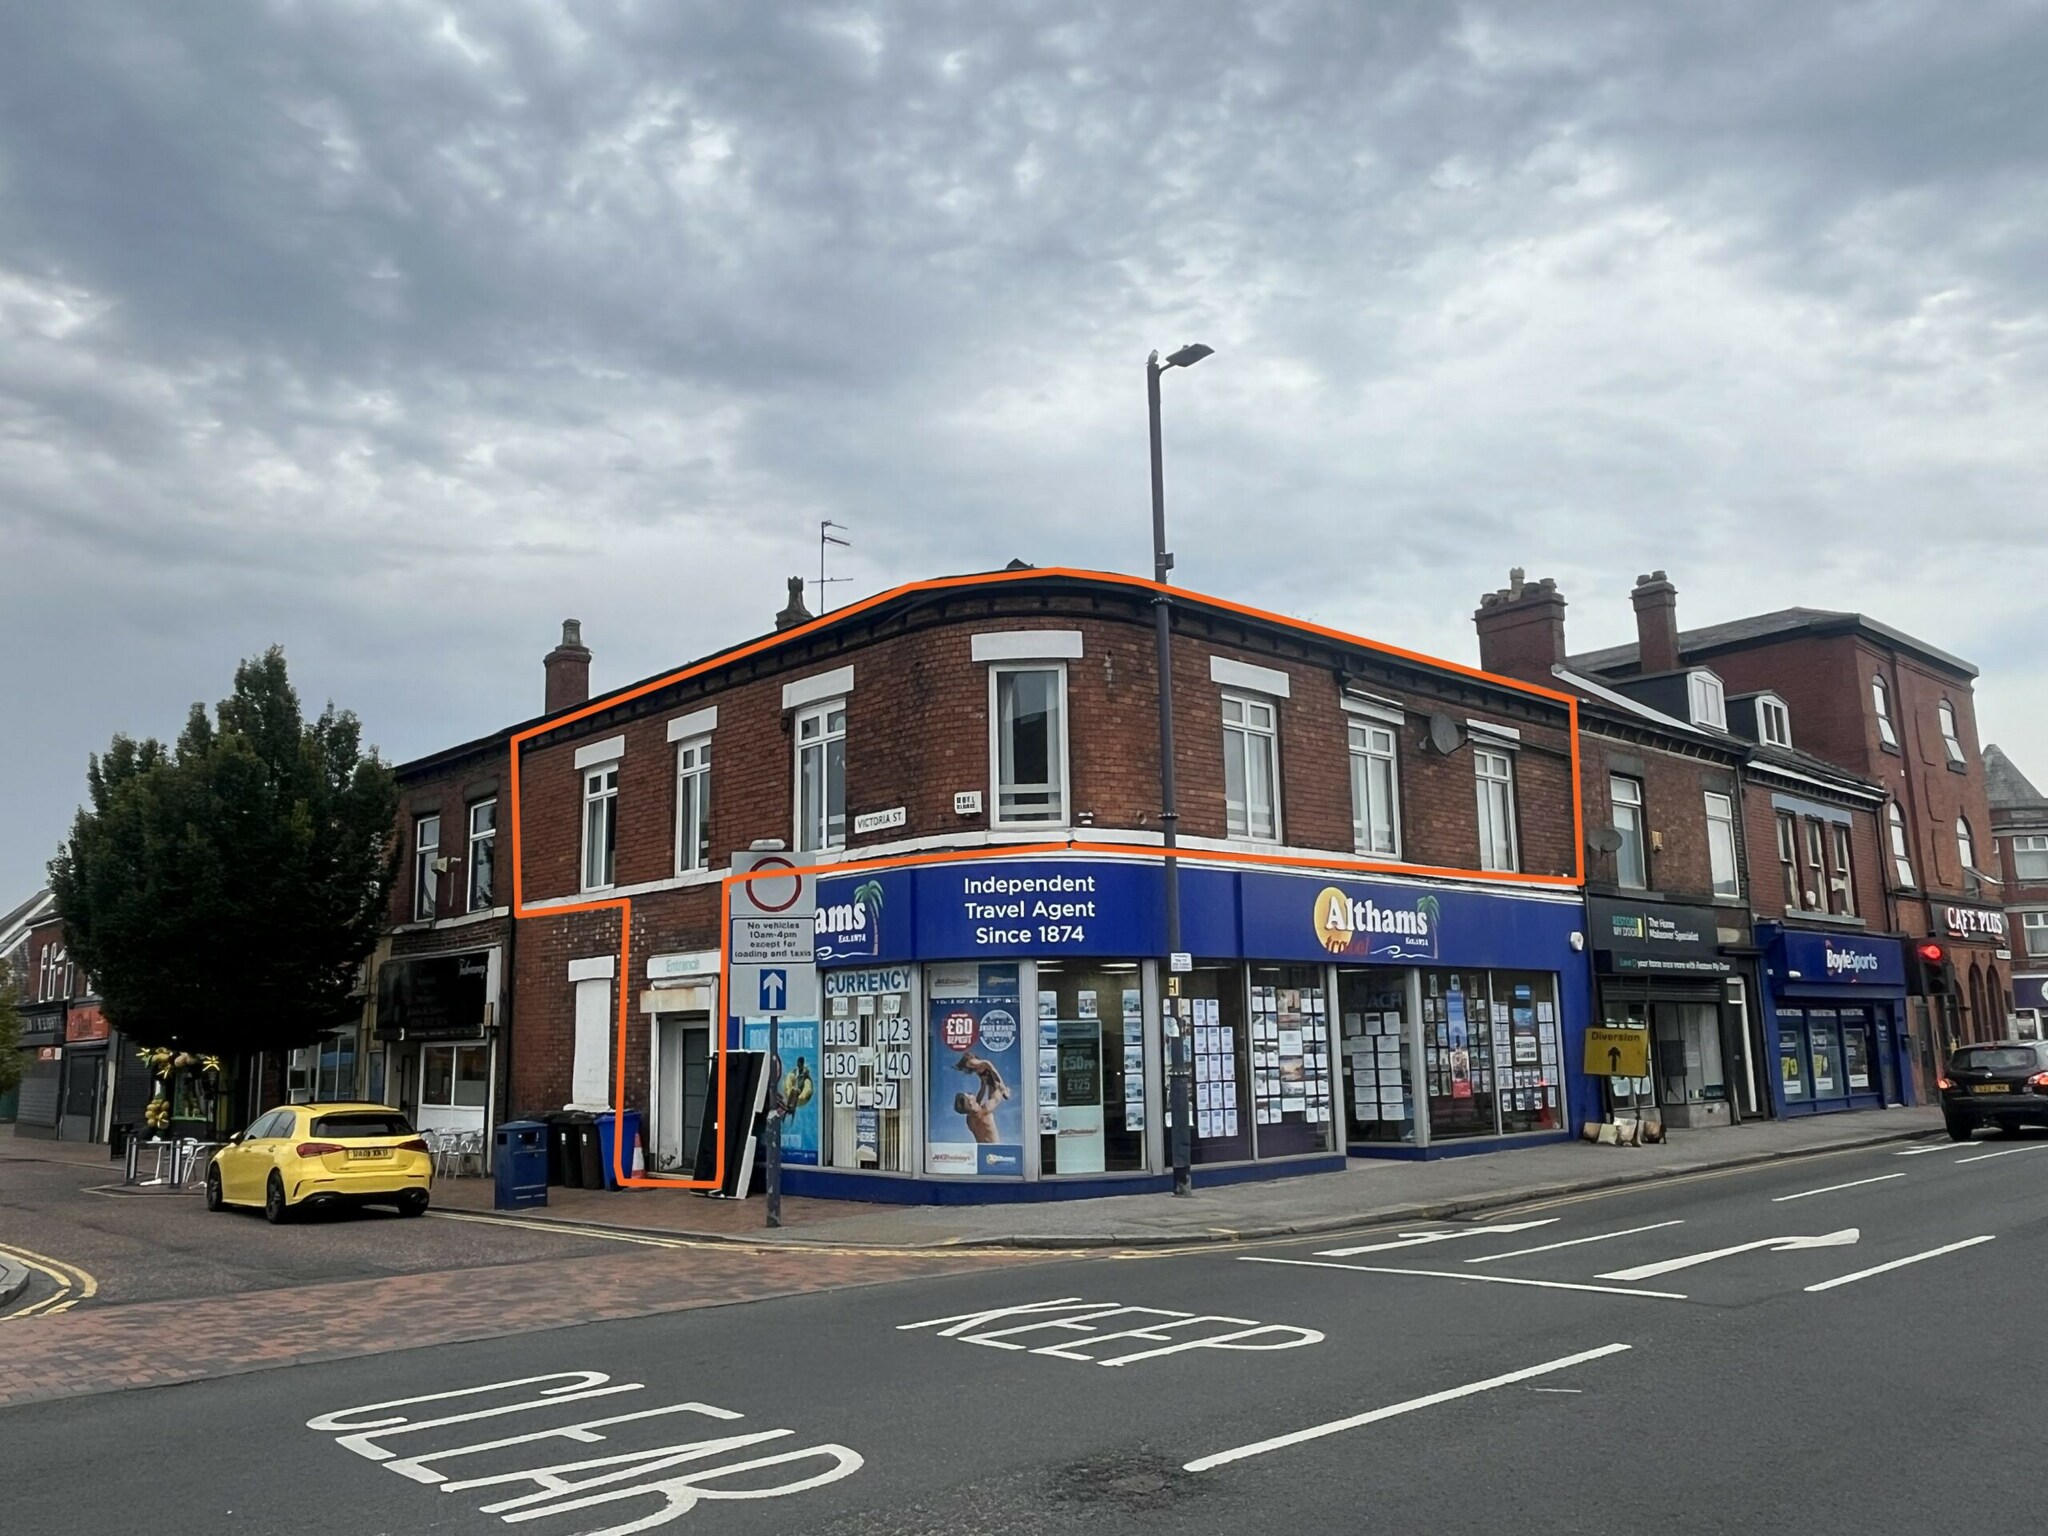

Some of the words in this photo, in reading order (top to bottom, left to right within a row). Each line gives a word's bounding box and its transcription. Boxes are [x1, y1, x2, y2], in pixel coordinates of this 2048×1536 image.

[856, 814, 891, 828] VICTORIA
[964, 874, 1096, 896] Independent
[815, 902, 866, 934] ams
[964, 900, 1025, 919] Travel
[1032, 900, 1096, 920] Agent
[1325, 896, 1428, 935] Althams
[750, 930, 797, 939] 10am-4pm
[763, 921, 800, 929] vehicles
[976, 926, 1032, 944] Since
[1038, 925, 1085, 943] 1874
[734, 949, 768, 958] loading
[771, 949, 787, 957] and
[750, 941, 780, 949] except
[1826, 949, 1878, 973] BoyleSports
[826, 968, 911, 995] CURRENCY
[825, 1020, 858, 1043] 113
[878, 1018, 911, 1042] 123
[945, 1018, 973, 1035] £60
[1591, 1031, 1640, 1042] Diversion
[825, 1053, 857, 1076] 130
[875, 1052, 911, 1076] 140
[835, 1082, 855, 1105] 50
[875, 1083, 896, 1107] 57
[896, 1297, 1326, 1367] KEEP
[306, 1371, 866, 1536] CLEAR
